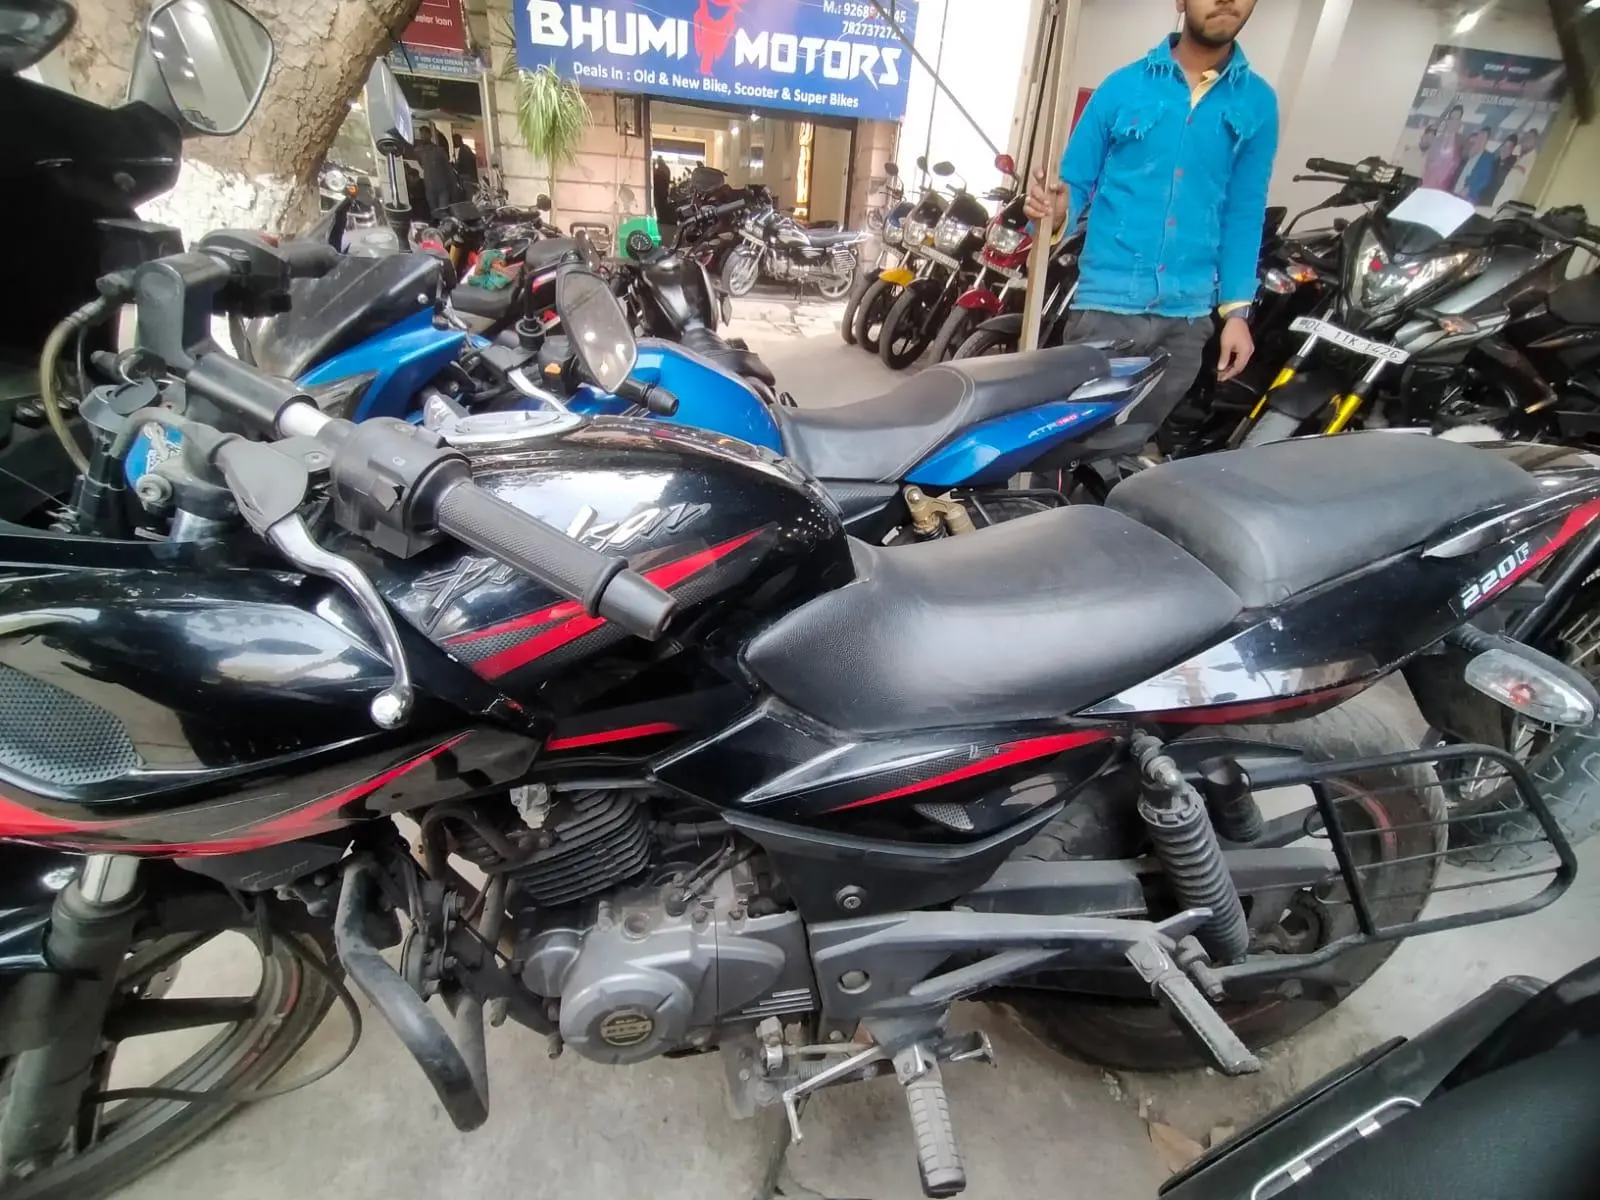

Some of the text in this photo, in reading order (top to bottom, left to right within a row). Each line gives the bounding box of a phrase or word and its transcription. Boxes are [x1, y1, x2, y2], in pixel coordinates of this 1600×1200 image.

[434, 16, 453, 27] loan
[526, 0, 902, 91] BHUMI MOTORS
[573, 61, 859, 108] Deals In : Old & New Bike, Scooter & Super Bikes
